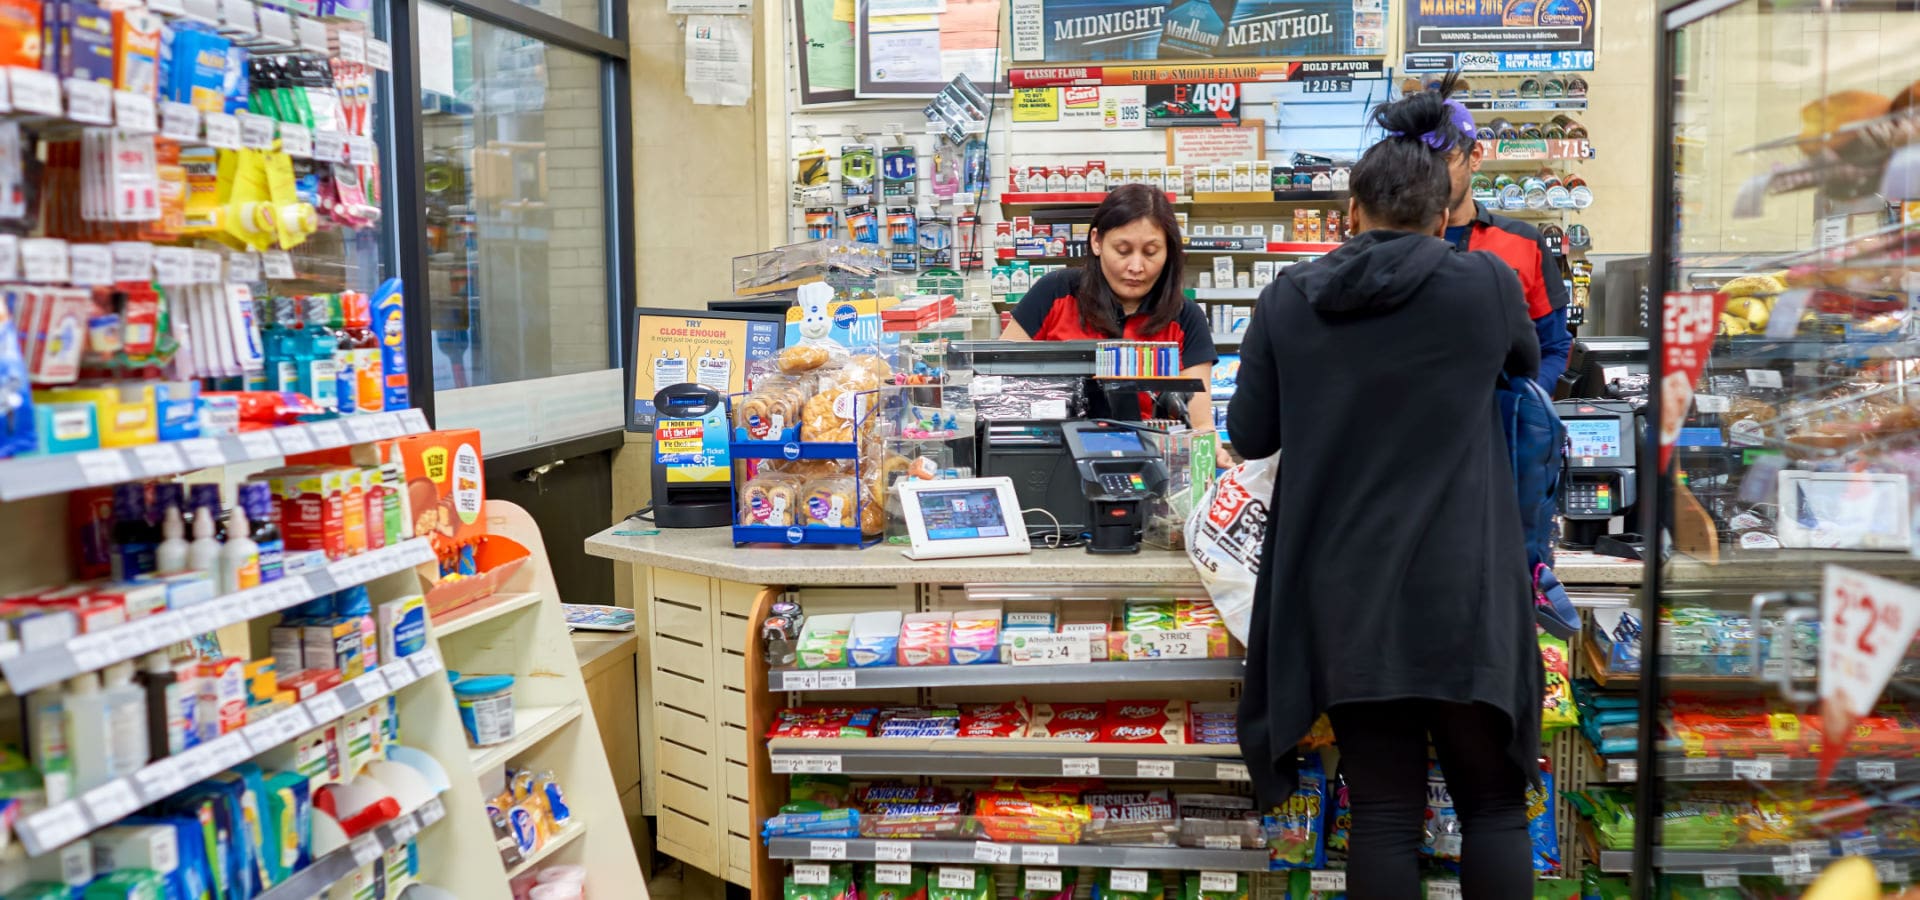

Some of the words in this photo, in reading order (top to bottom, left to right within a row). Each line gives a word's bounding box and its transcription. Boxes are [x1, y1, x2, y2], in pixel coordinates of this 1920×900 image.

[1420, 0, 1475, 15] MARCH
[1480, 0, 1503, 15] 2016
[1054, 6, 1165, 41] MIDNIGHT
[1541, 12, 1584, 25] Copenhagen
[1167, 18, 1220, 46] Marlboro
[1227, 13, 1333, 47] MENTHOL
[1303, 62, 1329, 72] BOLD
[1331, 61, 1369, 71] FLAVOR
[1024, 69, 1056, 79] CLASSIC
[1058, 68, 1087, 78] FLAVOR
[1132, 70, 1156, 81] RICH
[1172, 68, 1214, 80] SMOOTH
[1218, 67, 1257, 79] FLAVOR
[1066, 91, 1097, 101] Card
[685, 320, 702, 328] TRY
[660, 328, 688, 336] CLOSE
[690, 329, 726, 338] ENOUGH
[1160, 632, 1192, 640] STRIDE
[1047, 649, 1054, 659] 2
[1165, 645, 1172, 653] 2
[885, 729, 941, 737] SNICKERS
[1111, 805, 1172, 822] HERSHEY'S
